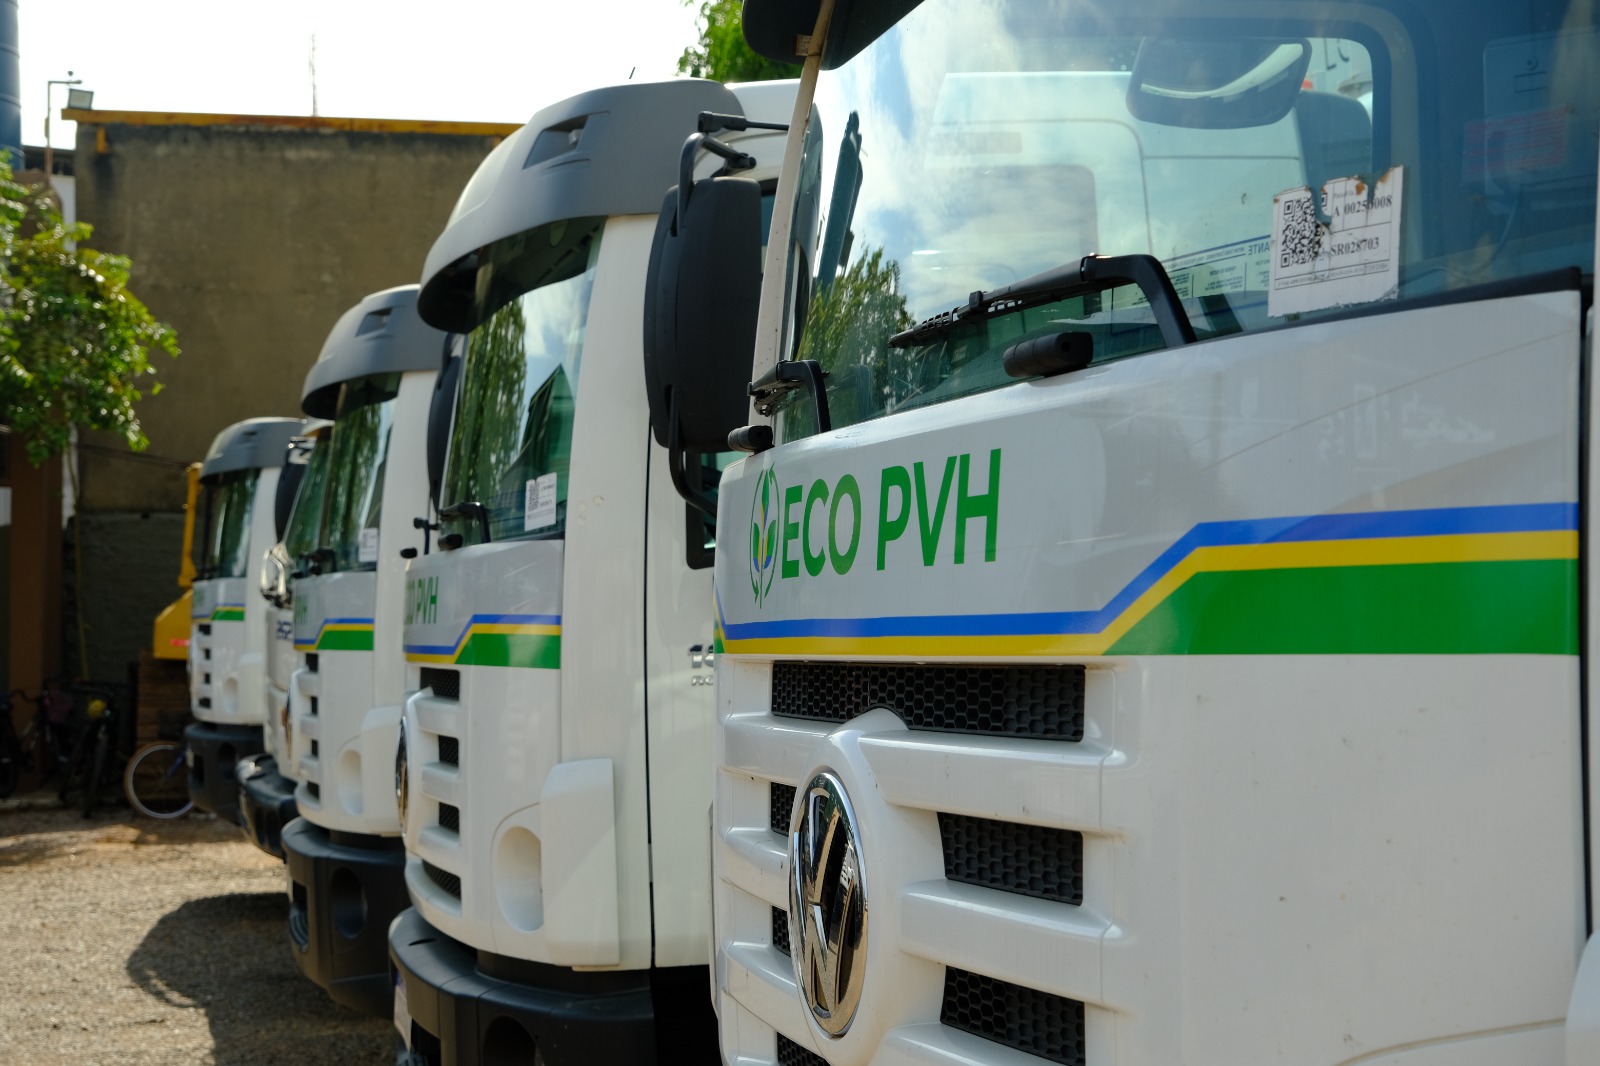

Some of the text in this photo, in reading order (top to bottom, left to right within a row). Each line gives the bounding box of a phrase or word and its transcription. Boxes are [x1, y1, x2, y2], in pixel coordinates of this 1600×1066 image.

[1330, 237, 1379, 257] SR028703
[781, 448, 1002, 579] ECO PVH
